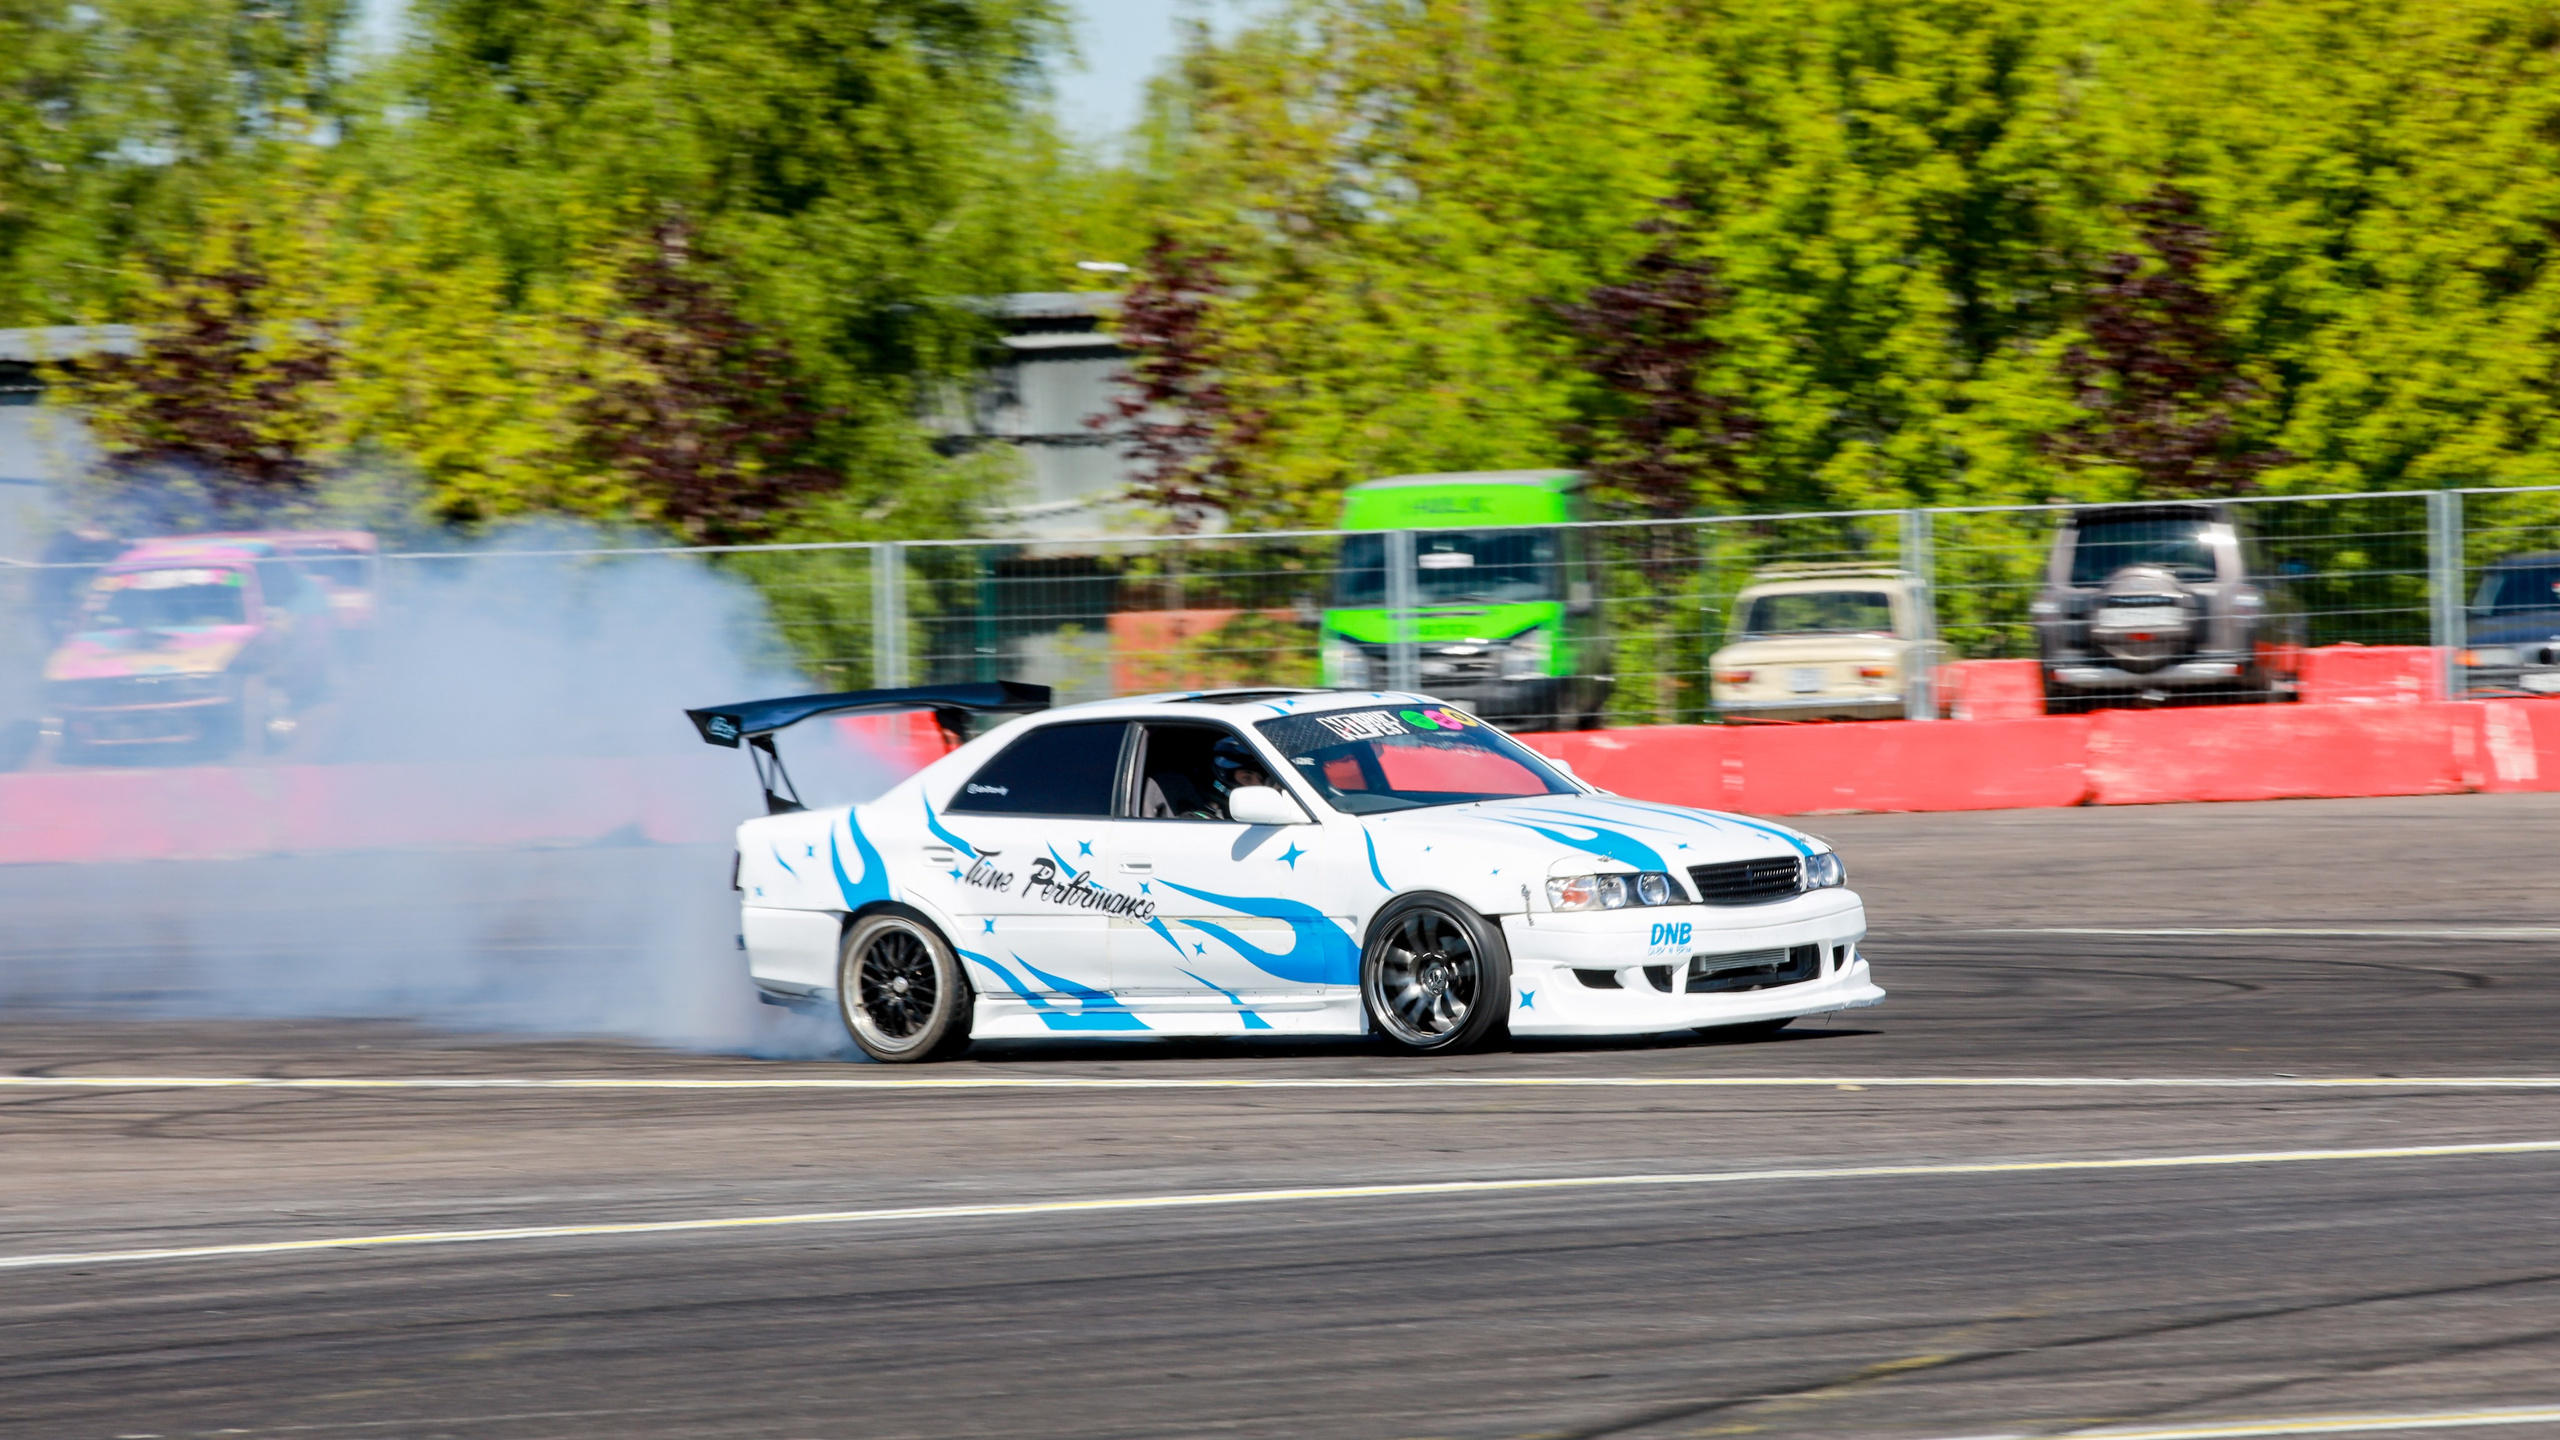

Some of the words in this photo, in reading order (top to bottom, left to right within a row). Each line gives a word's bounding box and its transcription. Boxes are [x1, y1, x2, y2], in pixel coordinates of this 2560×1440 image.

[965, 846, 1014, 893] Tune
[1022, 857, 1156, 921] Performance
[1650, 922, 1692, 946] DNB
